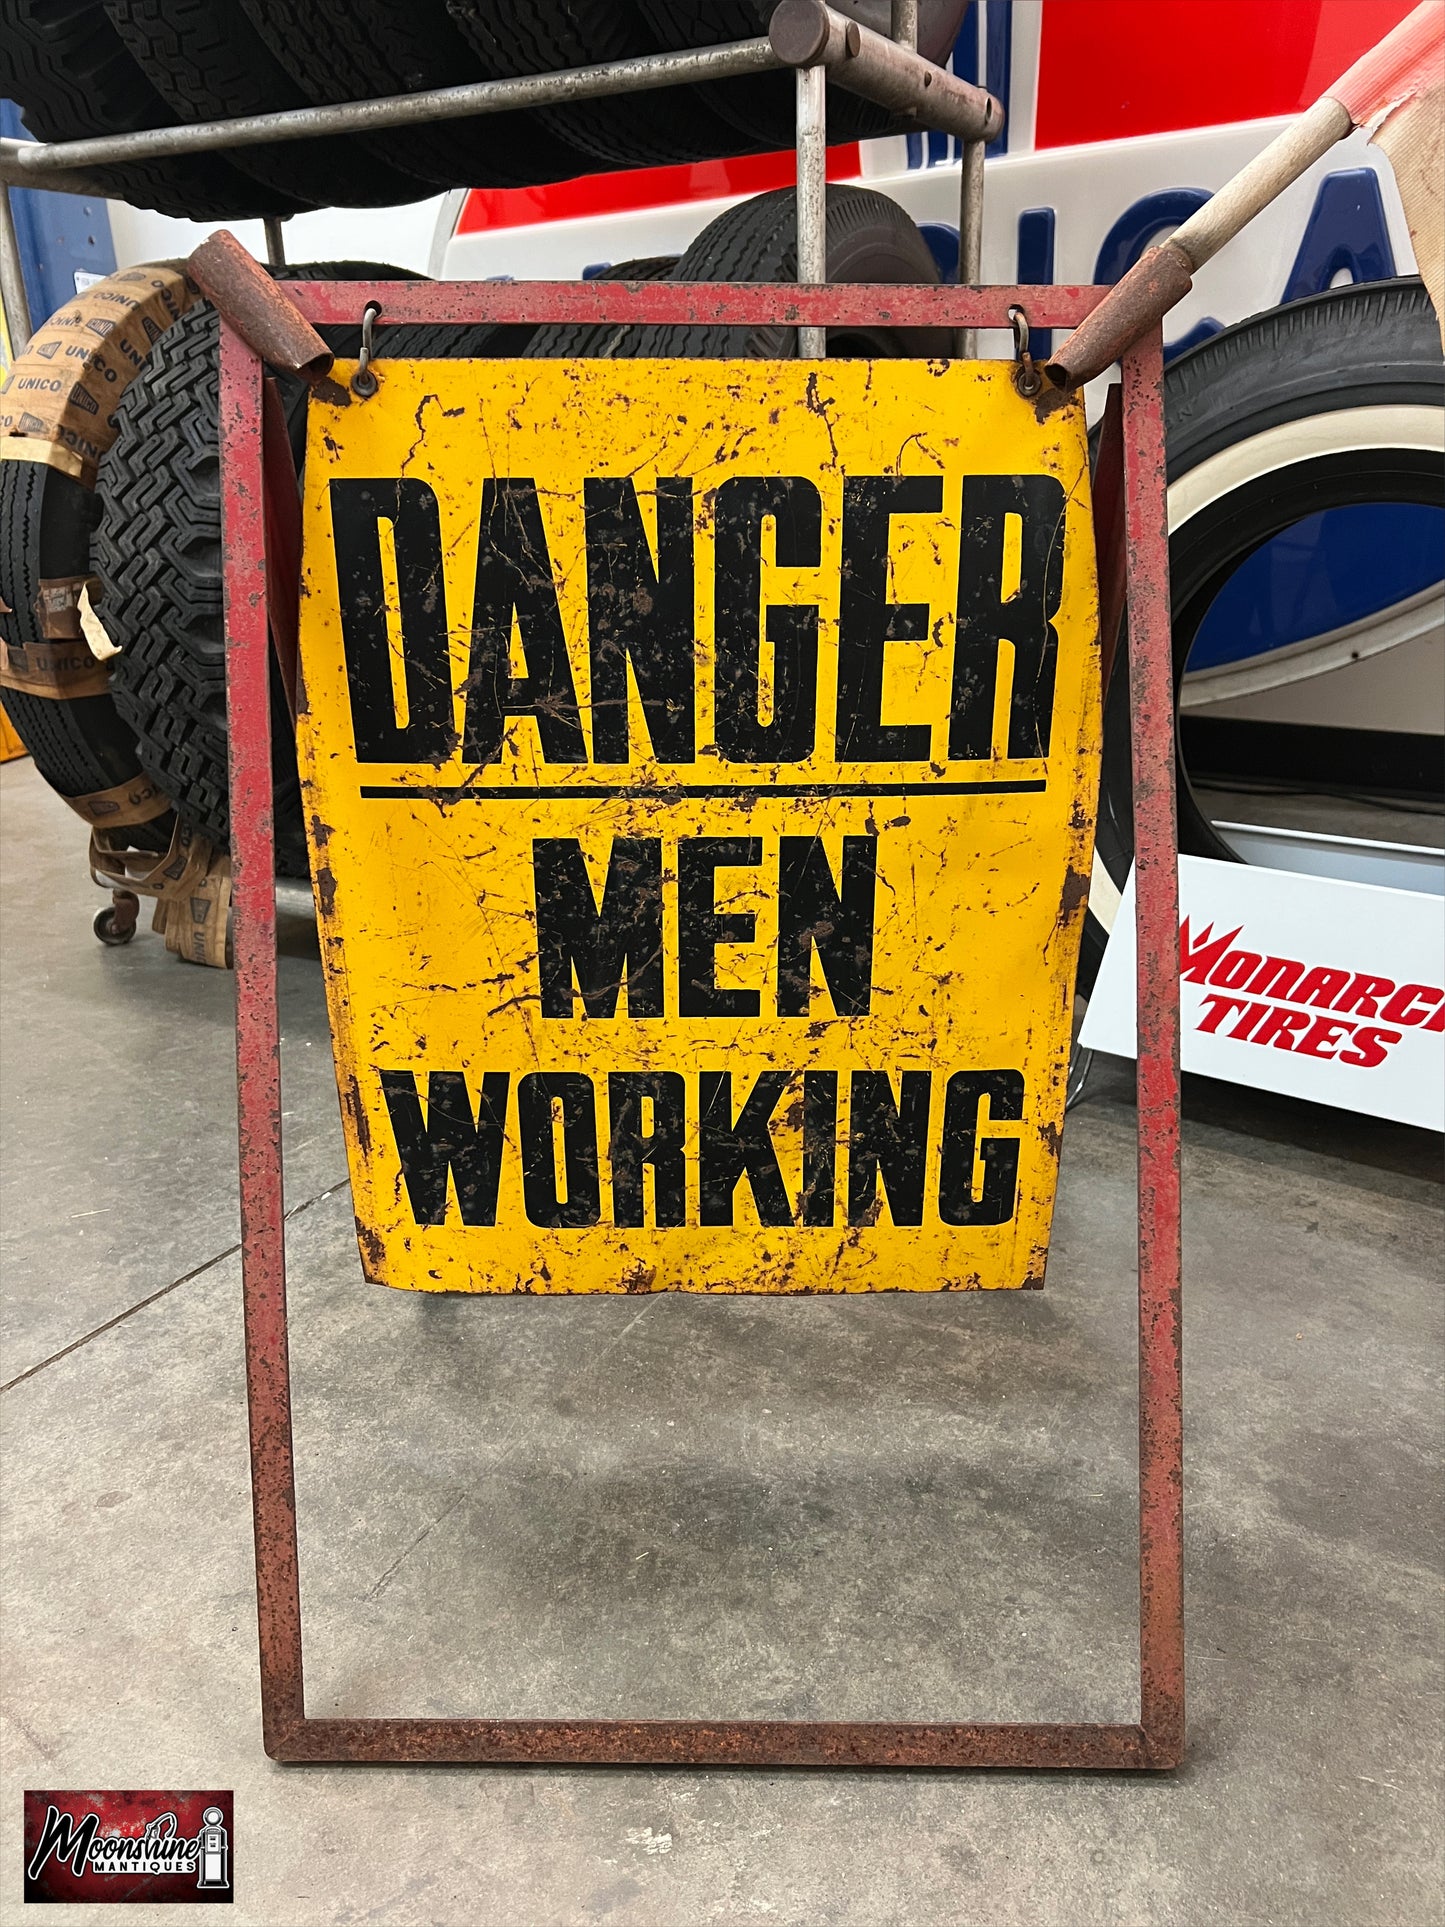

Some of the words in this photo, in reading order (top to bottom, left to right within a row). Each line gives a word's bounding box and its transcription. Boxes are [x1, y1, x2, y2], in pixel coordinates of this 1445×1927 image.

[93, 291, 142, 312] UNICO
[17, 378, 62, 392] UNICO
[71, 385, 98, 414] UNICO
[329, 475, 1066, 766] DANGER
[532, 836, 878, 1020] MEN
[1178, 914, 1445, 1033] MONARC
[1194, 992, 1403, 1068] TIRES
[376, 1068, 1024, 1230] WORKING
